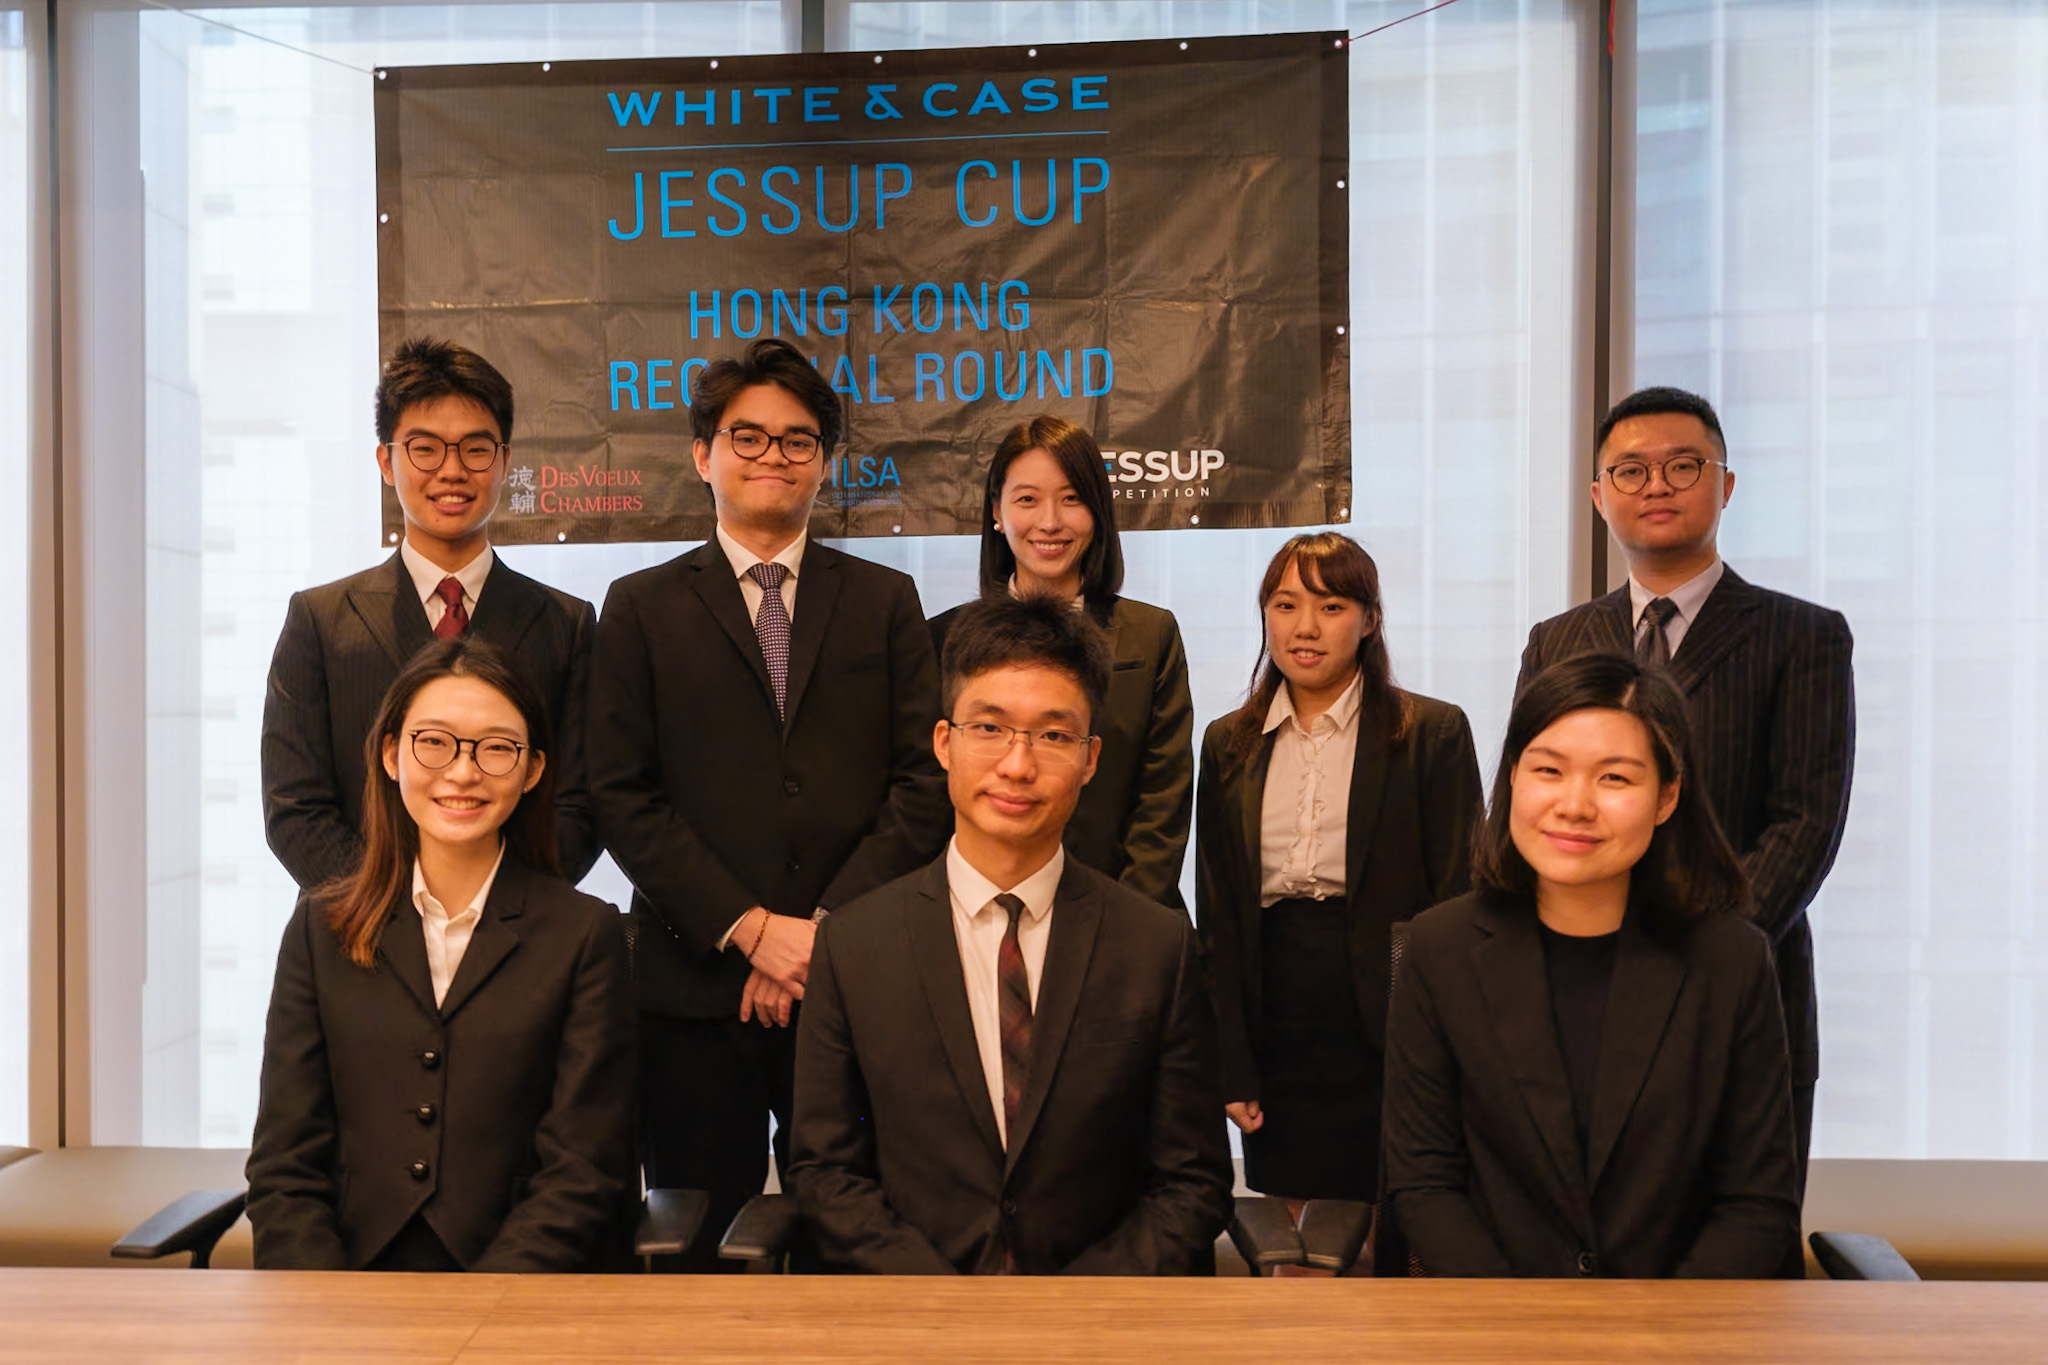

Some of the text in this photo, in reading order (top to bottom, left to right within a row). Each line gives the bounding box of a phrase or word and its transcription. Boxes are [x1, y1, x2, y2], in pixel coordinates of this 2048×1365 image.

[608, 75, 1110, 128] WHITE & CASE
[609, 157, 1110, 240] JESSUP CUP
[689, 280, 1030, 339] HONG KONG
[609, 347, 1112, 411] REAL ROUND
[832, 456, 901, 488] ILSA
[1100, 449, 1225, 483] ESSUP
[540, 491, 643, 513] CHAMBERS
[1112, 487, 1210, 499] PETITION
